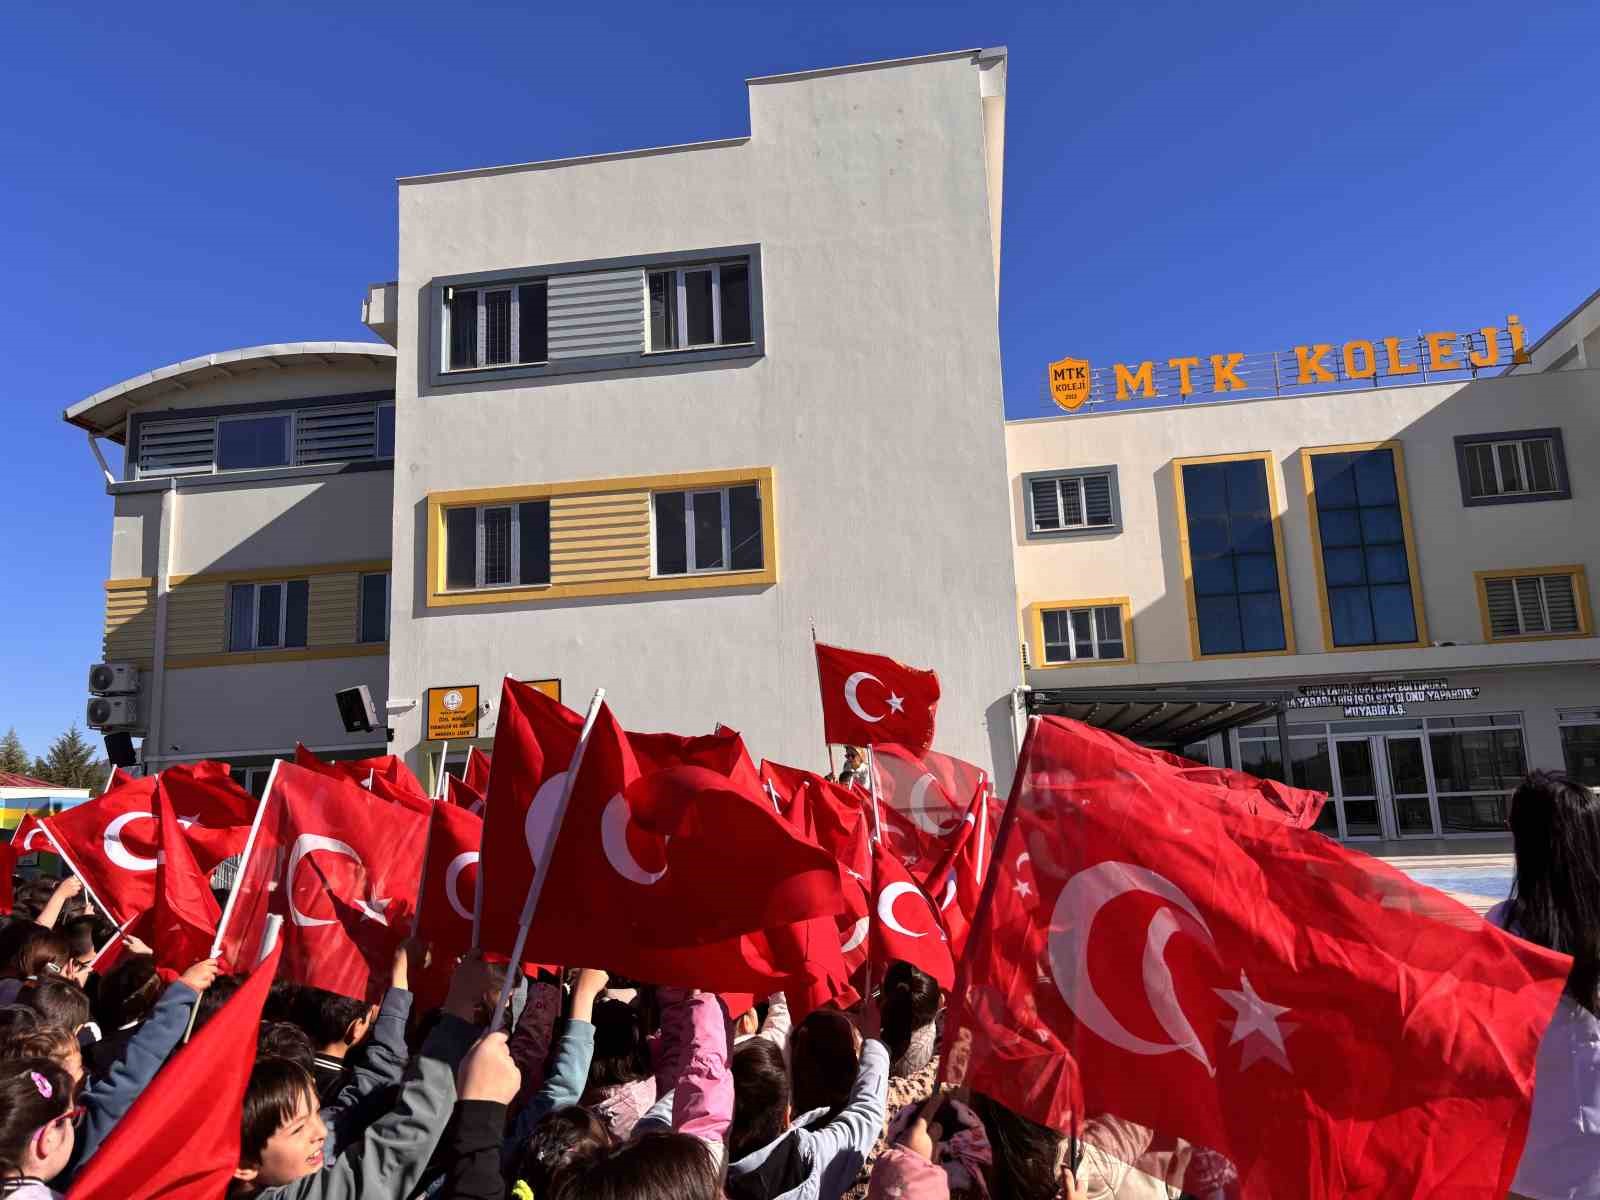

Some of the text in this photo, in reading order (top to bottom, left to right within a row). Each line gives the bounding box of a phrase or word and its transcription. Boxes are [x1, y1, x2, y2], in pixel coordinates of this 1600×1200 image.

[1113, 314, 1531, 400] MTK KOLEJİ
[1054, 367, 1086, 381] MTK
[1405, 691, 1425, 702] ONU
